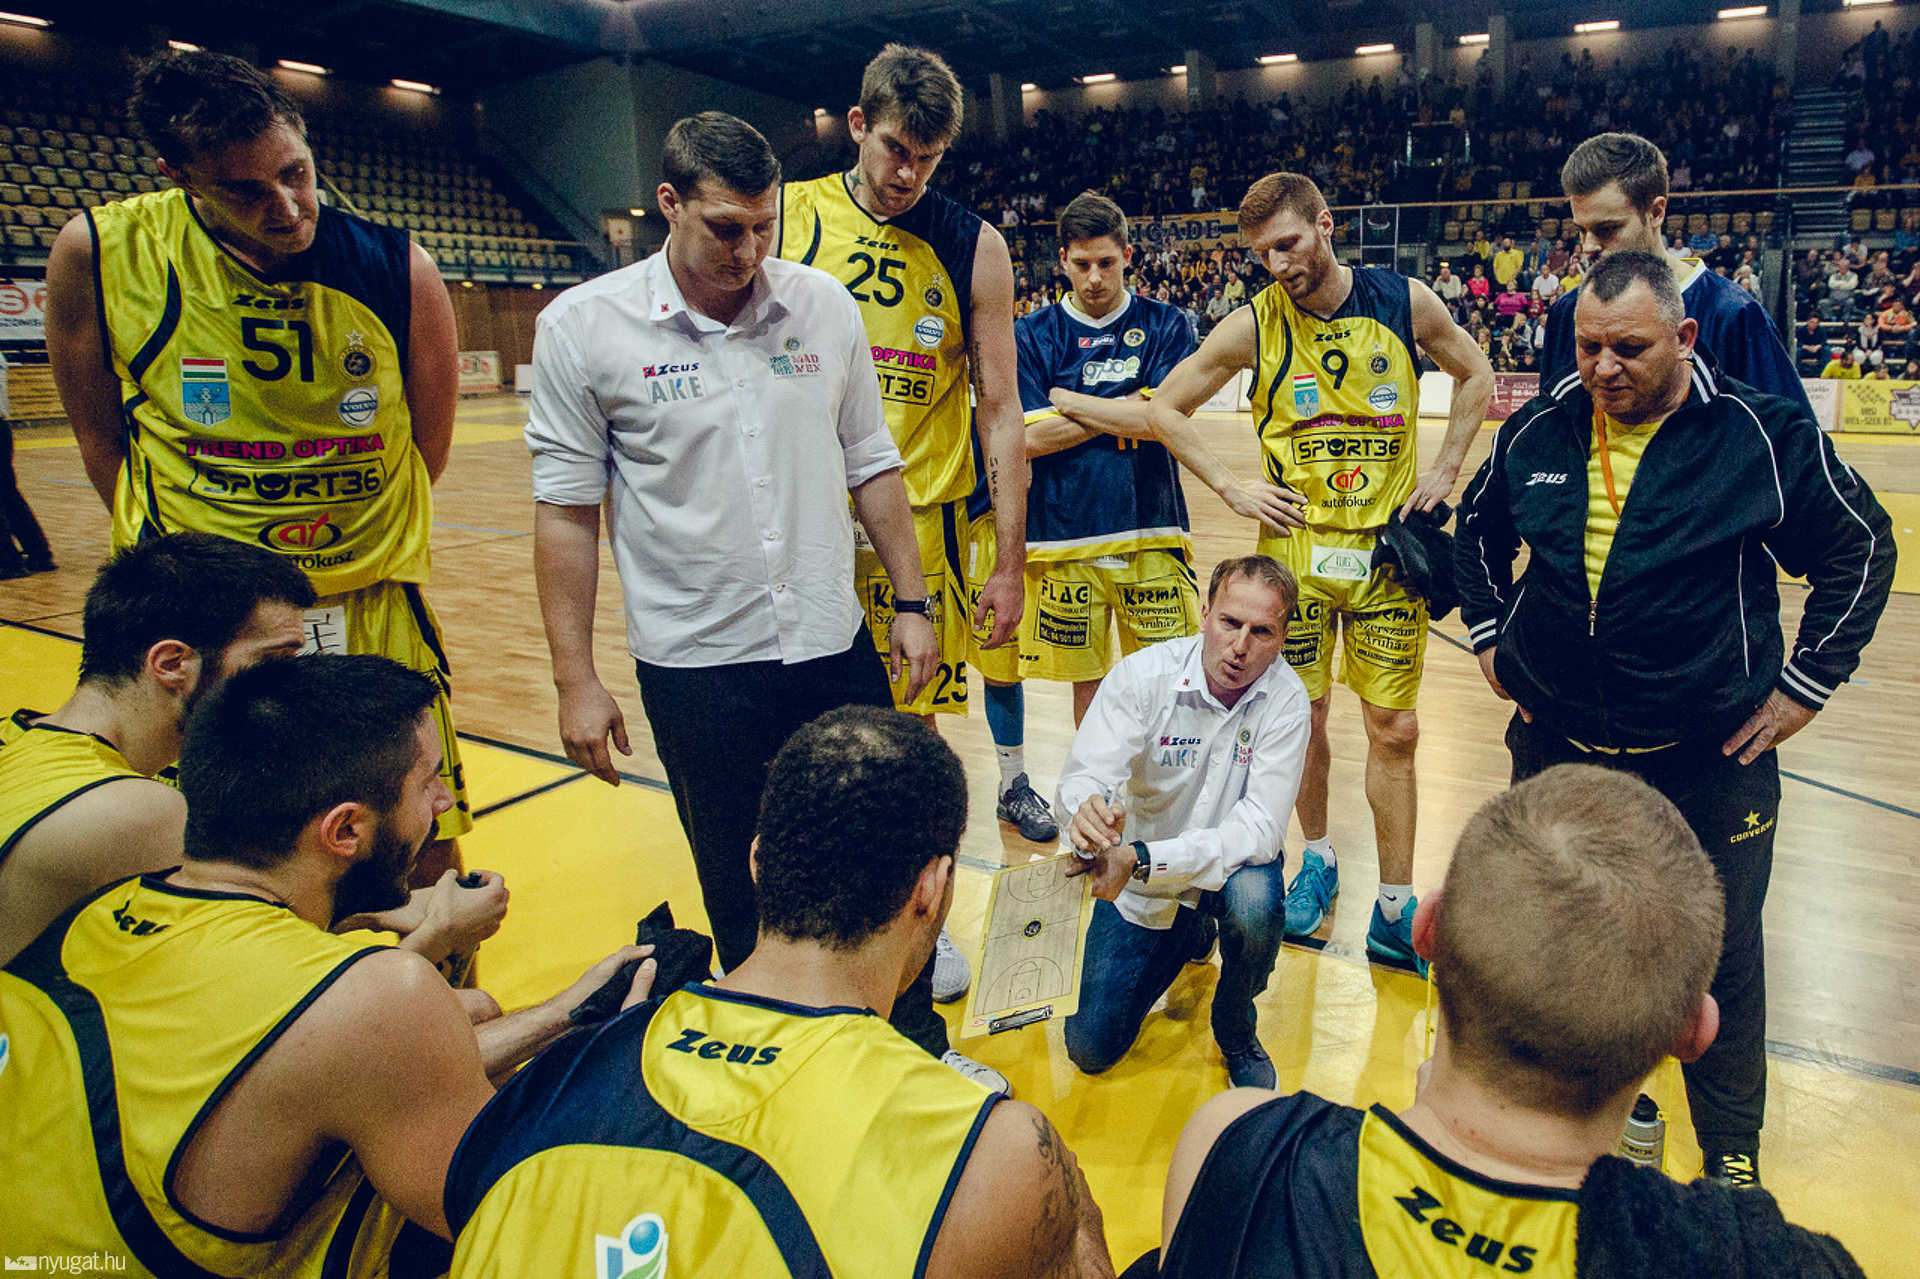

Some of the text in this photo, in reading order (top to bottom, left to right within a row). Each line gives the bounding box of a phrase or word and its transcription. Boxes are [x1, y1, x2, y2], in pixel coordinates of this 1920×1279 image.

[855, 236, 899, 251] Zeus
[1128, 220, 1222, 242] IGADE
[846, 252, 907, 307] 25
[232, 293, 305, 310] Zeus
[1313, 329, 1351, 342] Zeus
[240, 316, 315, 383] 51
[871, 346, 937, 371] OPTIKA
[656, 362, 700, 377] Zeus
[1321, 348, 1349, 390] 9
[651, 376, 704, 404] AKE
[342, 400, 378, 412] VOLVO
[180, 433, 385, 460] TREND OPTIKA
[1042, 578, 1089, 604] FLAG
[932, 661, 968, 705] 25
[1169, 736, 1201, 746] Zeus
[665, 1028, 782, 1067] Zeus
[1393, 1185, 1539, 1275] Zeus
